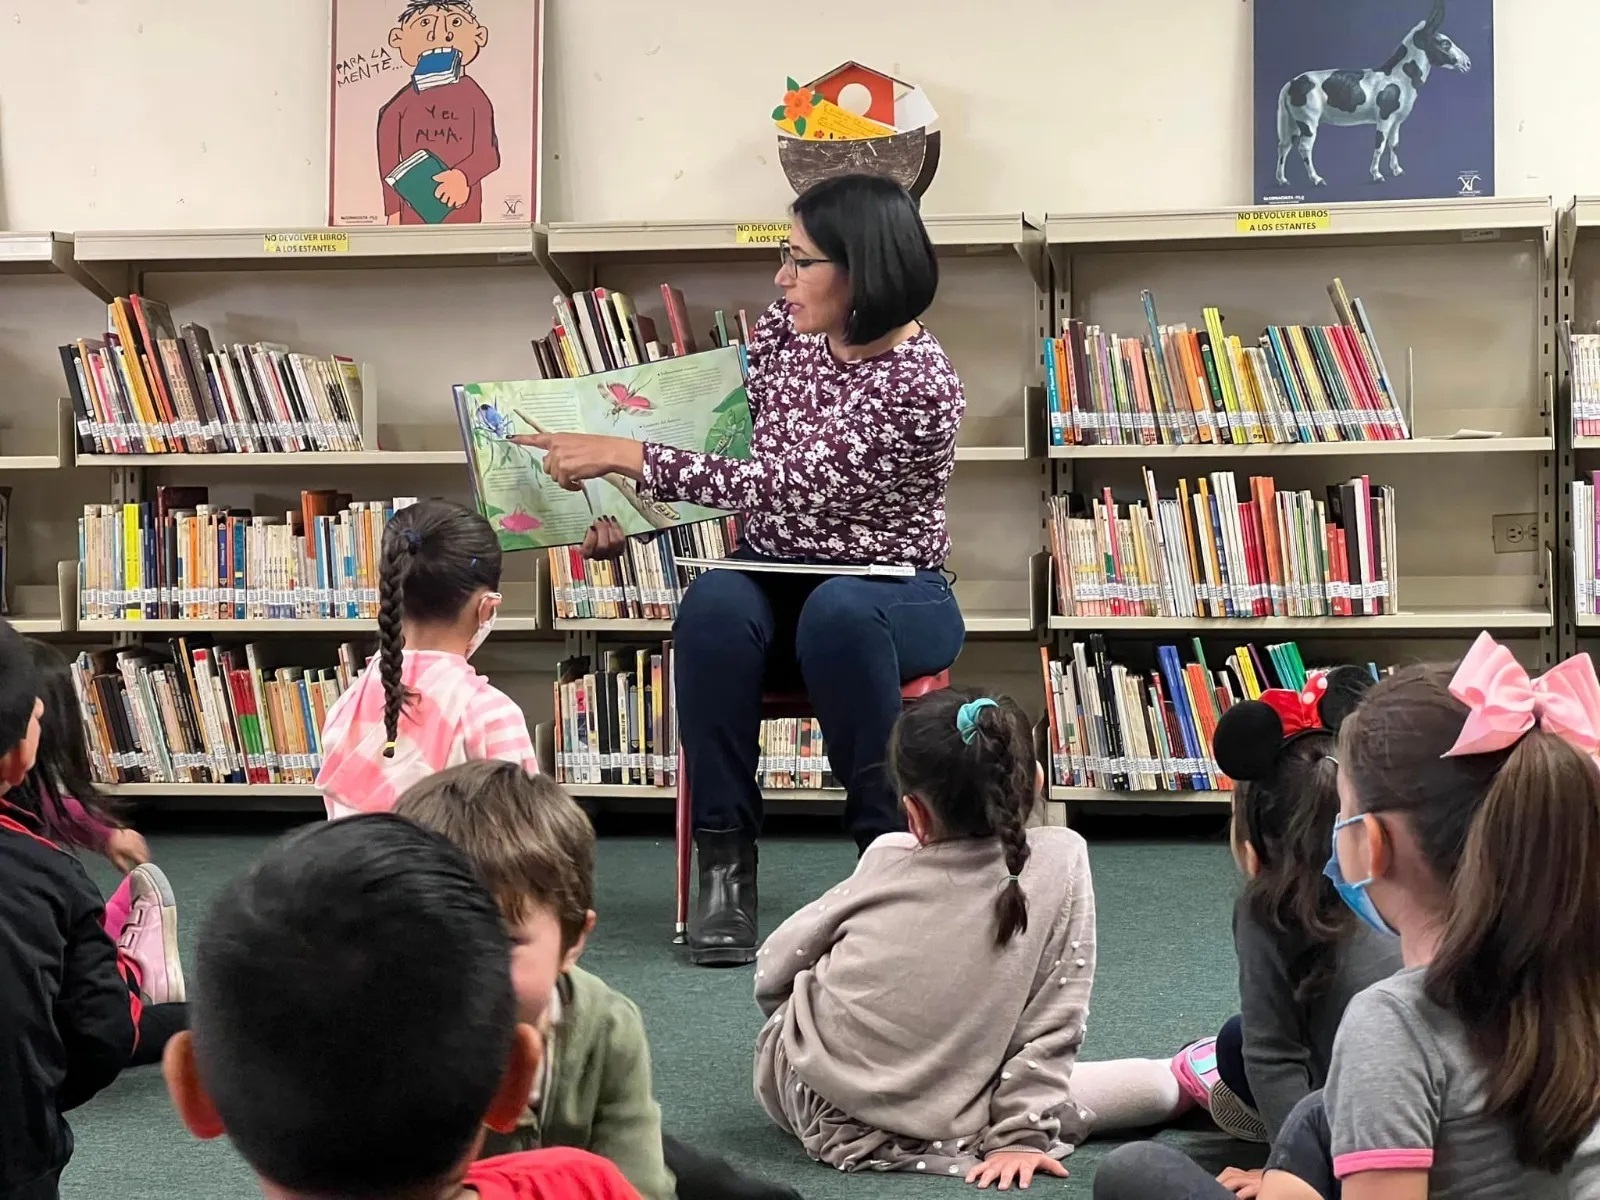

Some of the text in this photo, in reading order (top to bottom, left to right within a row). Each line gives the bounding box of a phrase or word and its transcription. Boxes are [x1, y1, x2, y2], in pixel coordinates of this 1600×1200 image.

[336, 47, 391, 75] PARA LA
[424, 104, 459, 121] Y EL
[415, 126, 463, 145] ALMA.
[1237, 210, 1328, 220] NO DEVOLVER LIBROS
[1257, 223, 1273, 231] LOS
[1275, 222, 1316, 231] ESTANTES
[264, 233, 347, 242] NO DEVOLVER LIBROS
[282, 245, 297, 253] LOS
[299, 244, 336, 253] ESTANTES
